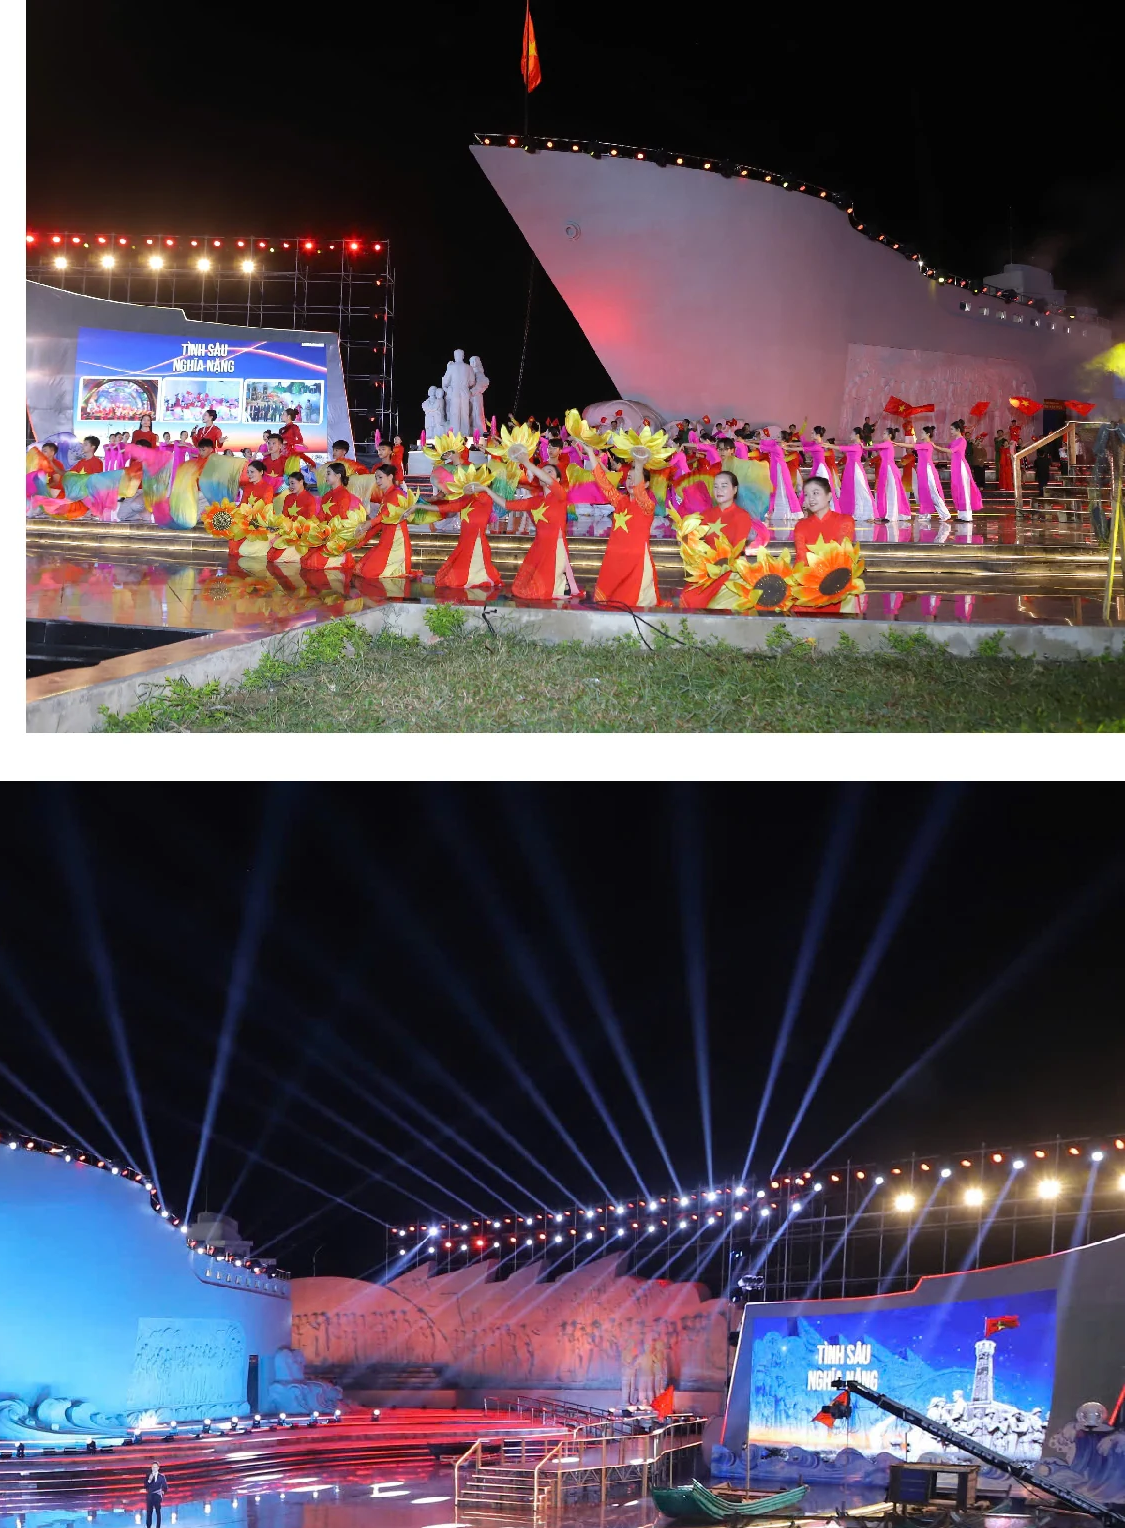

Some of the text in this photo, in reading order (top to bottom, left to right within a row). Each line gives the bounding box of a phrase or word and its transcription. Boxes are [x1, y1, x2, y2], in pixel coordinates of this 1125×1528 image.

[181, 341, 228, 357] TÌNH SÂU
[172, 357, 235, 374] NGHĨA NẶNG
[817, 1341, 872, 1365] TÌNH SÂU
